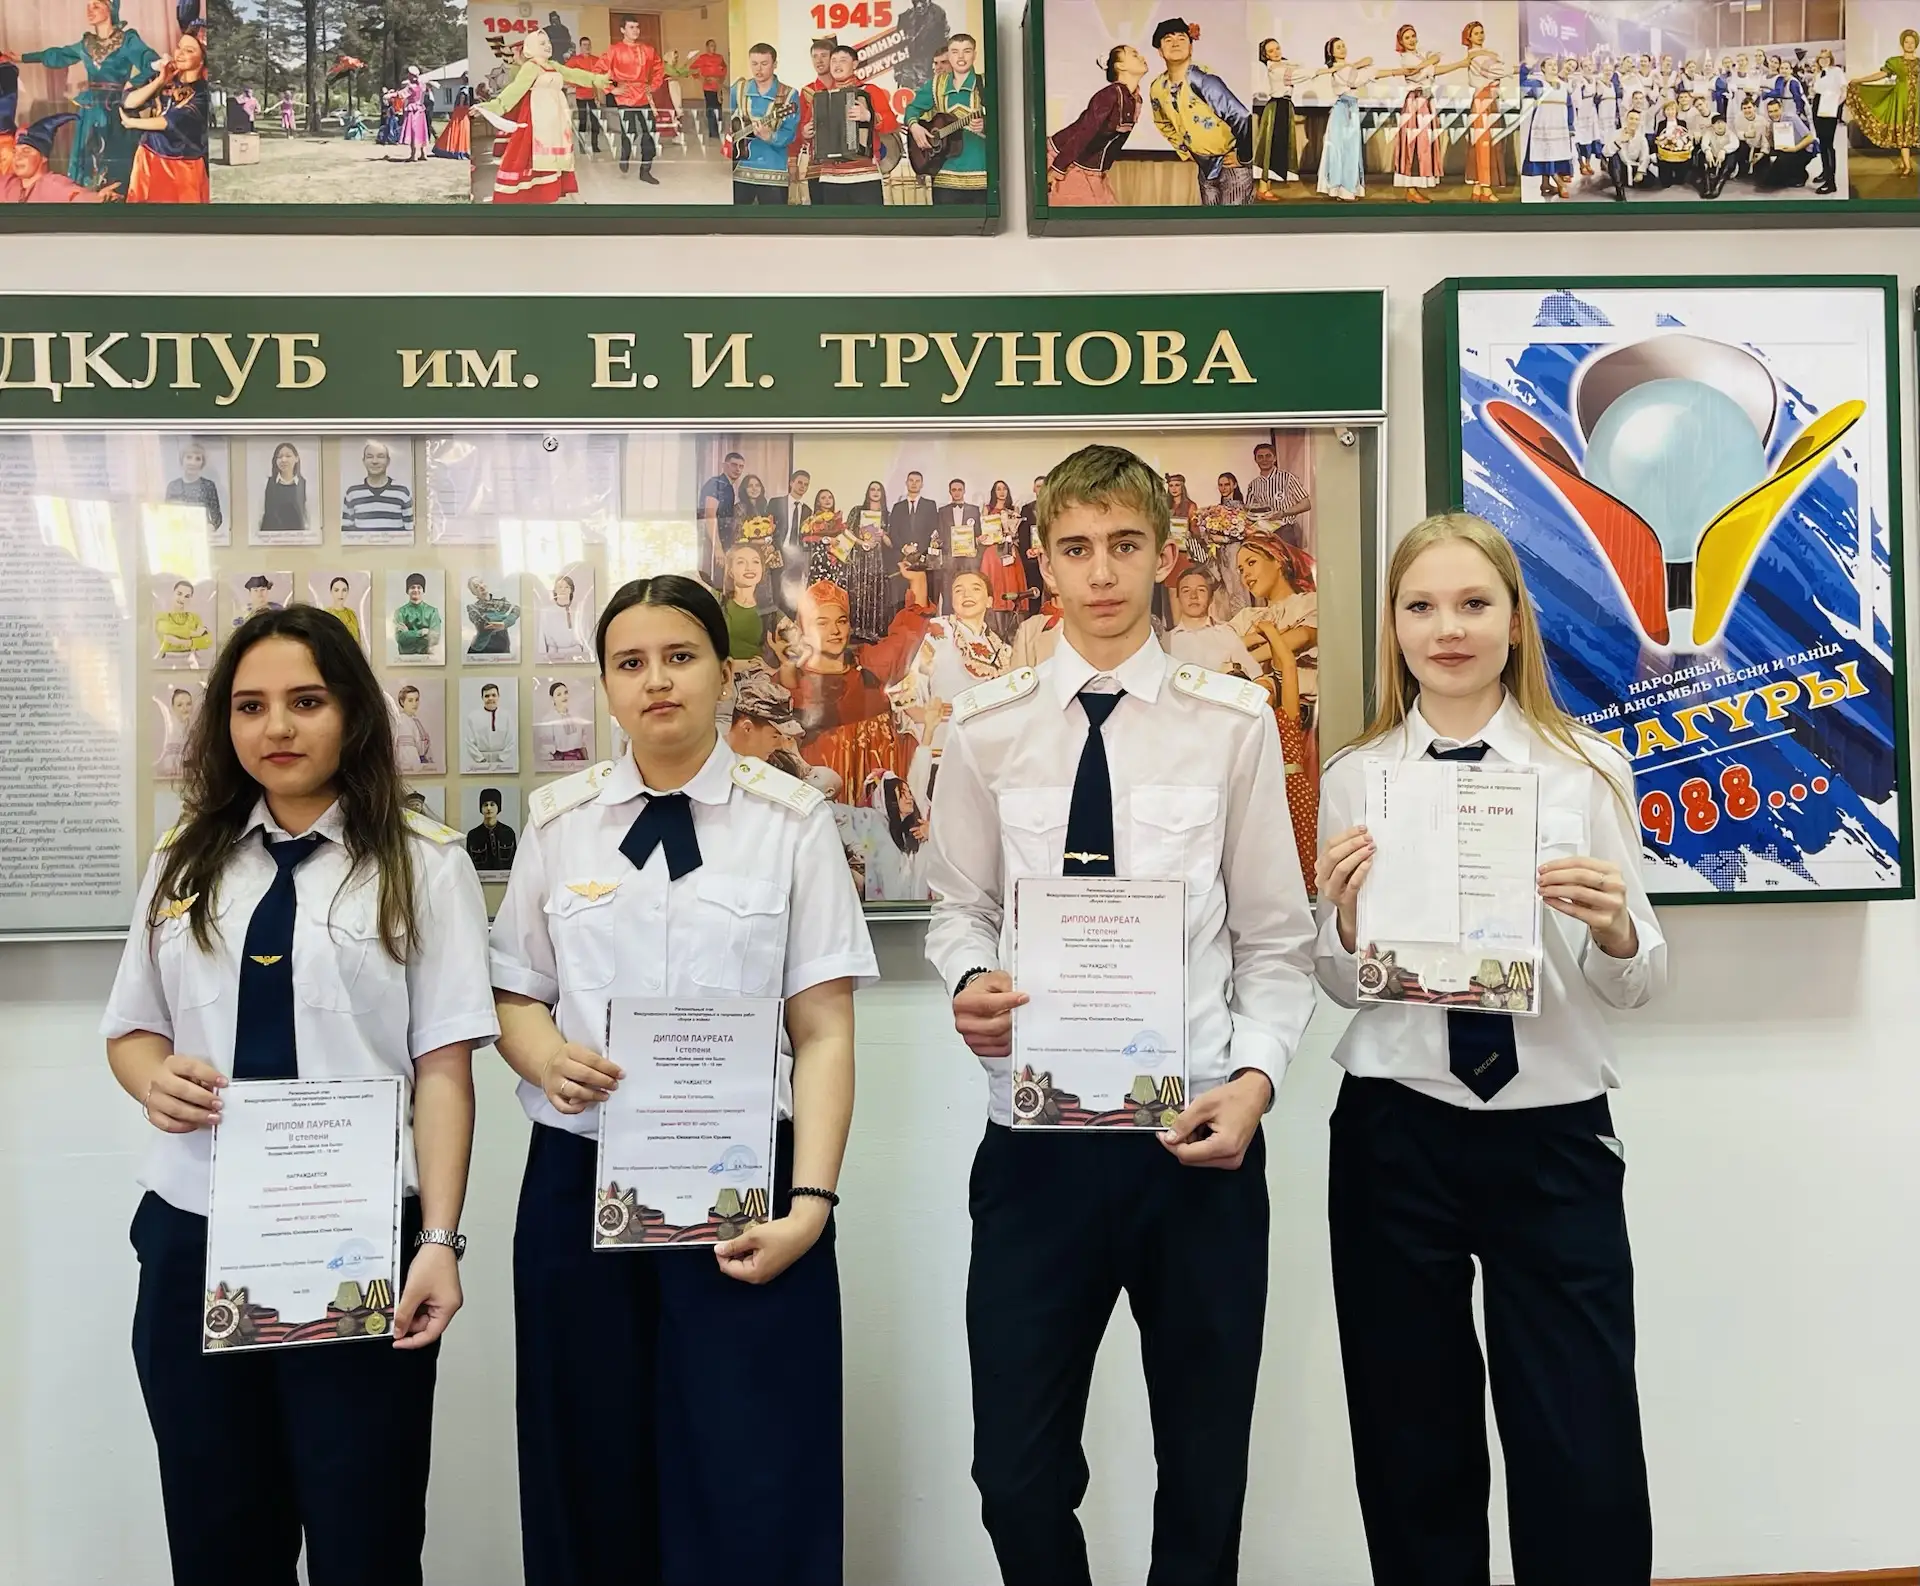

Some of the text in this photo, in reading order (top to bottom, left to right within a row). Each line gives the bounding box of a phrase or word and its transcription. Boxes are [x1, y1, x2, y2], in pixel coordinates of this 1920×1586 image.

[483, 16, 539, 33] 1945
[810, 1, 893, 29] 1945
[857, 29, 906, 62] ОМНЮ!
[854, 46, 910, 81] ОРЖУСЬ!
[396, 348, 540, 390] им.
[586, 331, 660, 390] Е.
[683, 331, 775, 390] И.
[819, 328, 1259, 405] ТРУНОВА
[1623, 678, 1712, 714] АНСАМБЛЬ
[1715, 664, 1770, 688] ПЕСНИ
[1771, 656, 1786, 671] И
[1787, 642, 1844, 667] ТАНЦА
[1627, 656, 1723, 695] НАРОДНЫЙ
[1458, 805, 1477, 815] АН
[1487, 806, 1514, 816] ПРИ
[1638, 763, 1830, 846] 988...
[1061, 914, 1141, 925] ДИПЛОМ ЛАУРЕАТА
[653, 1034, 734, 1043] ДИПЛОМ ЛАУРЕАТА
[265, 1118, 352, 1132] ДИПЛОМ ЛАУРЕАТА
[295, 1133, 329, 1142] степени
